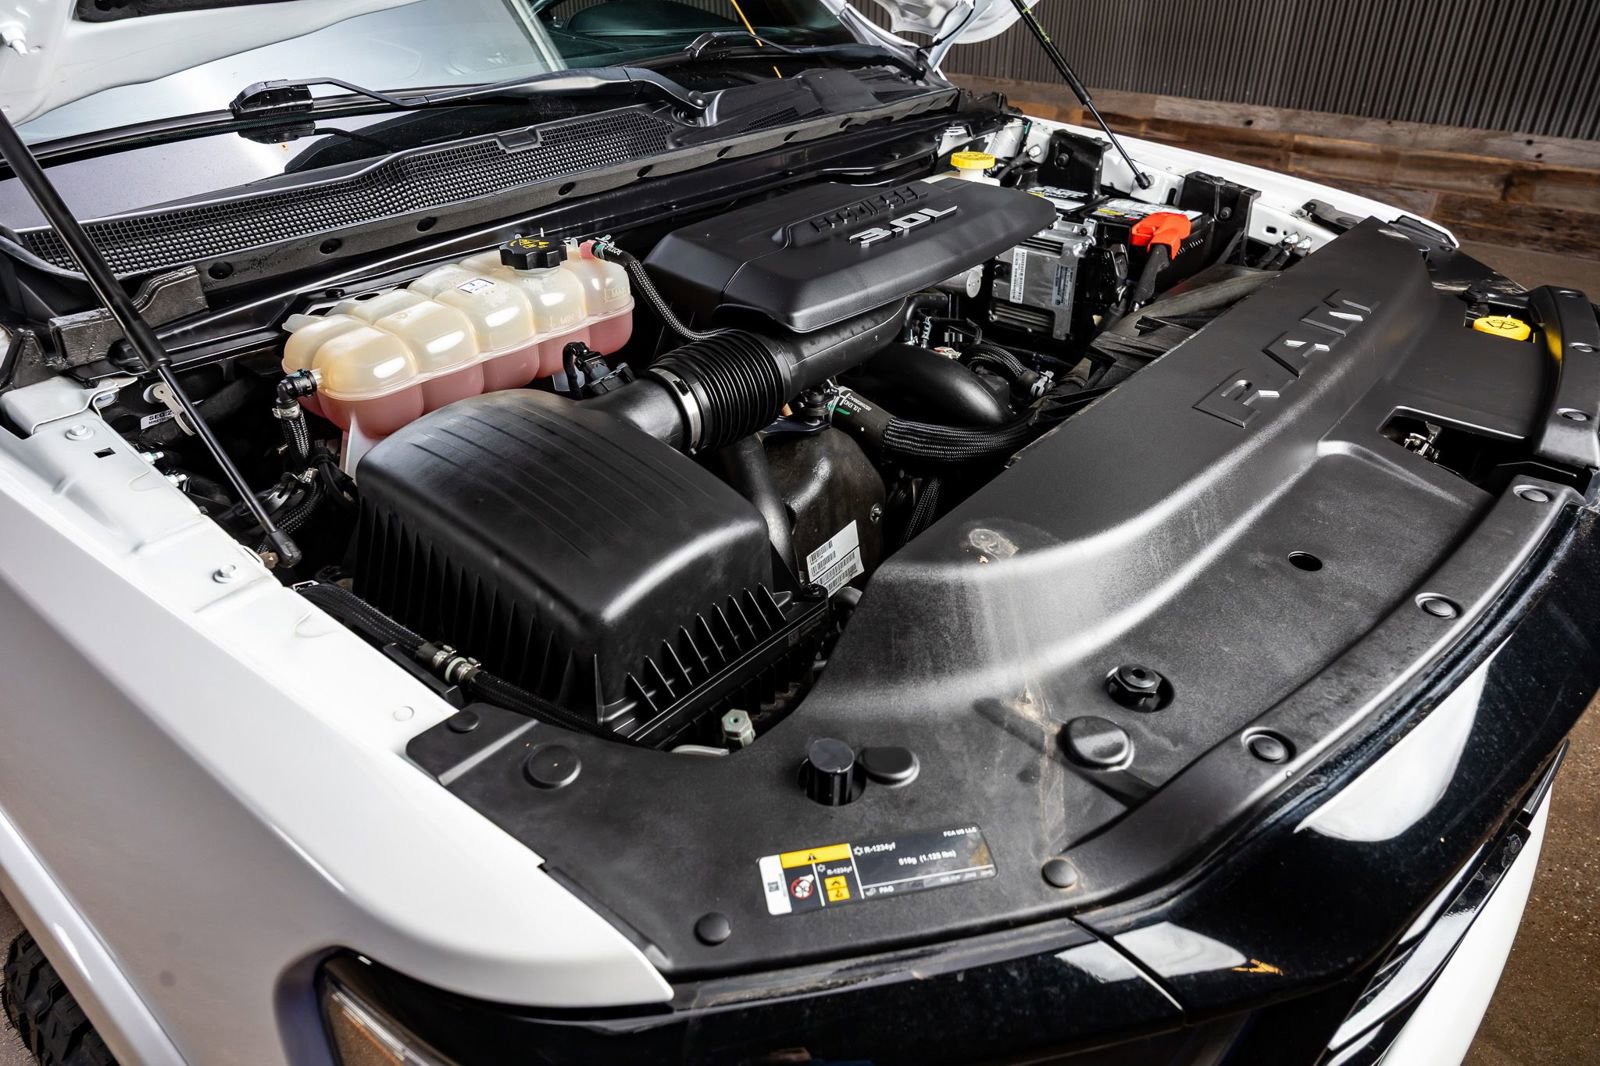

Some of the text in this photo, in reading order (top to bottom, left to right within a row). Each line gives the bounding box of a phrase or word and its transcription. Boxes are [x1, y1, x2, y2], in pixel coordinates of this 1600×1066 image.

[848, 205, 958, 247] 3.0L
[1192, 288, 1380, 429] RAM
[943, 829, 956, 837] FCA
[863, 842, 896, 854] R-1234yf
